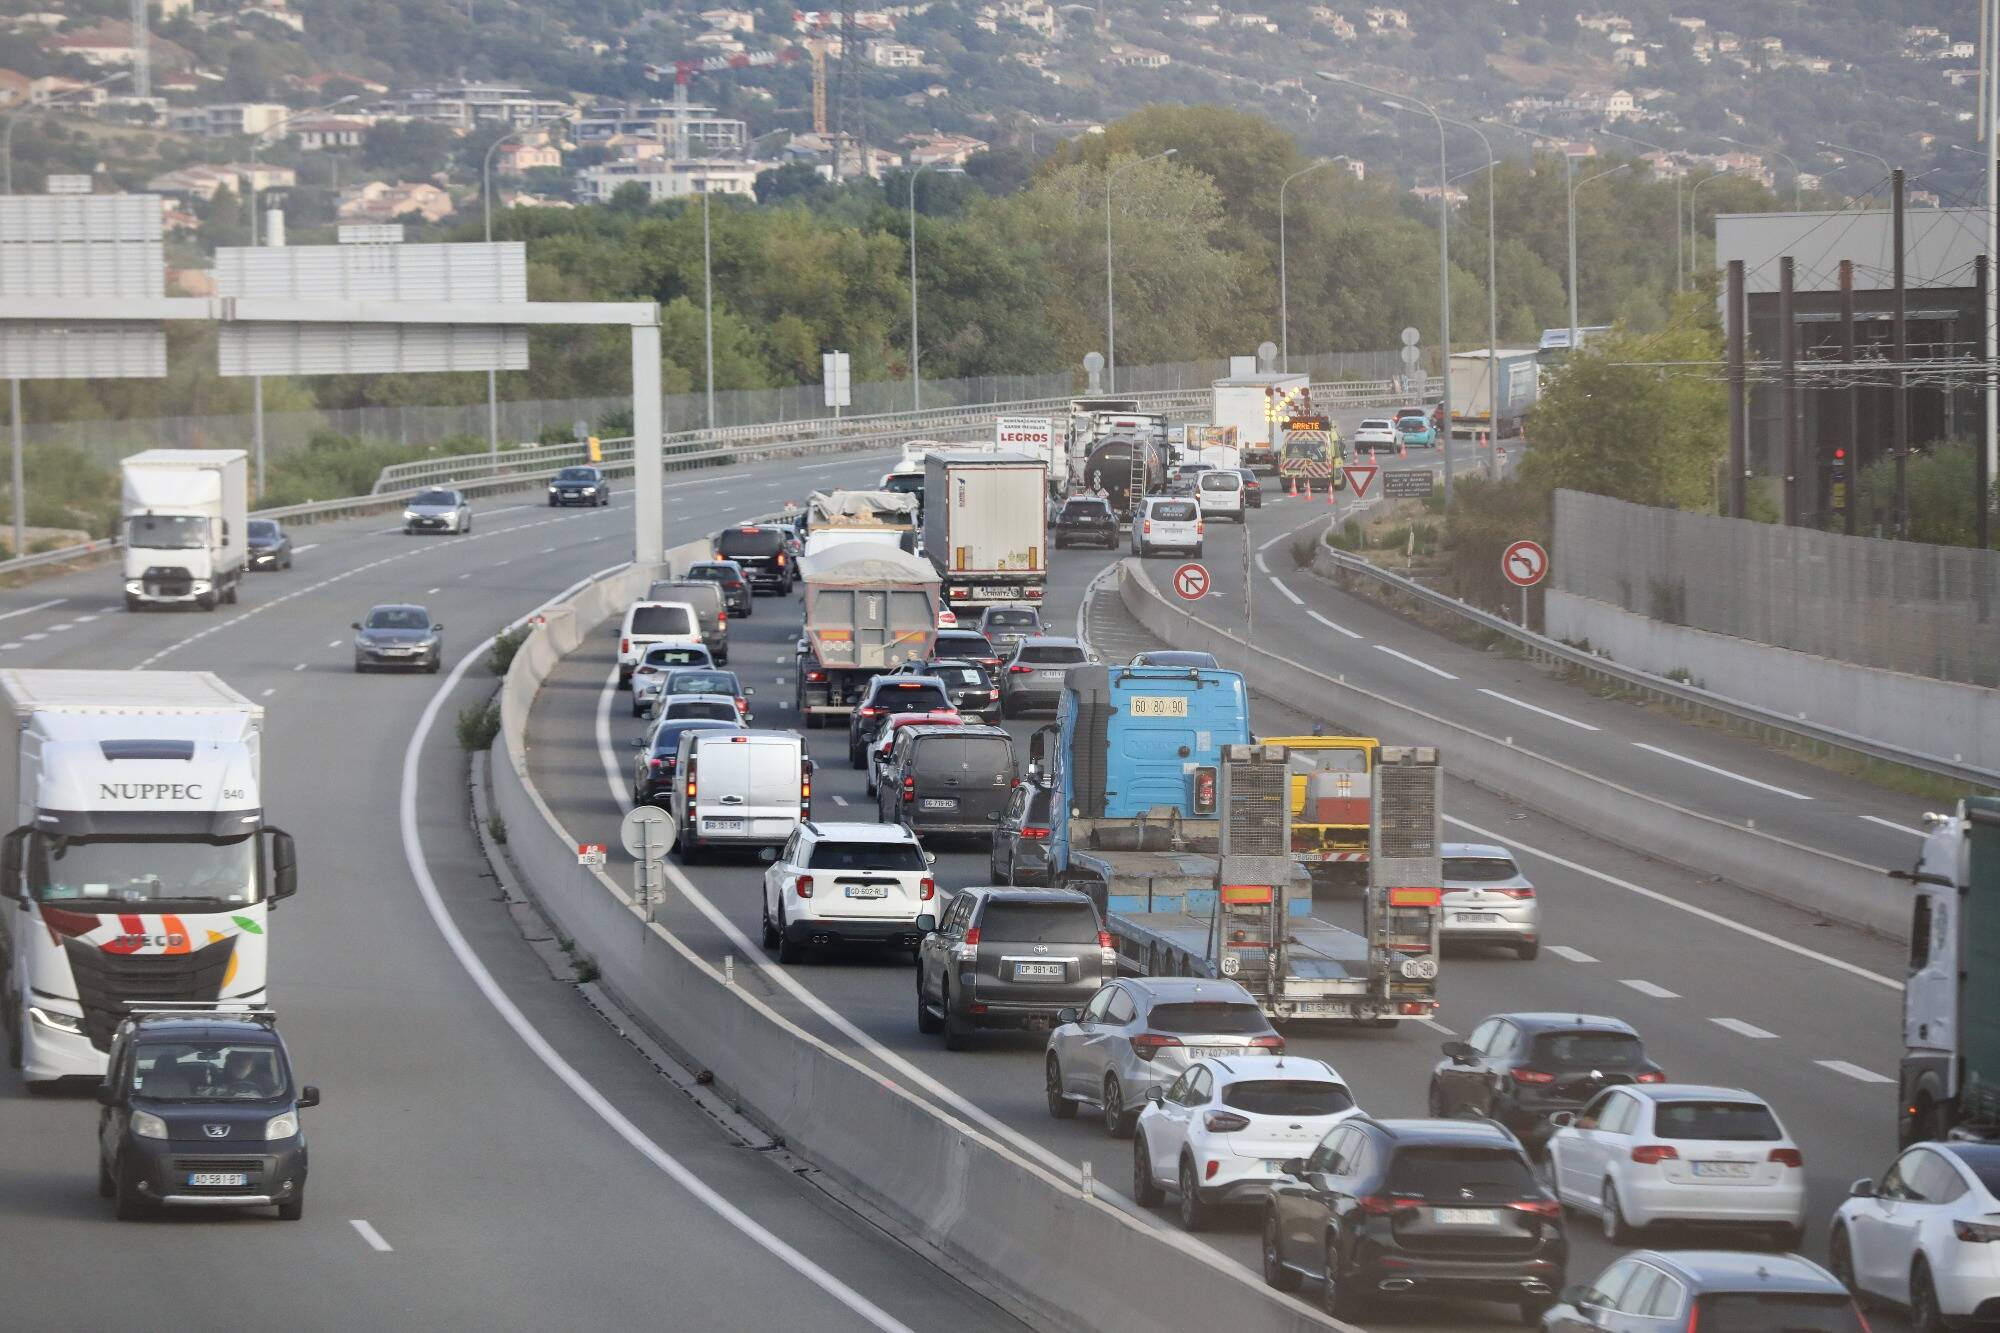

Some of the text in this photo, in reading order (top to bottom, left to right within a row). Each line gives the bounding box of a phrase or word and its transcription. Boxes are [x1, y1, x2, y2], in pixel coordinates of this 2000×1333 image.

[1000, 433, 1048, 442] LEGROS
[1135, 700, 1183, 714] 60 80 90
[99, 783, 203, 799] NUPPEC
